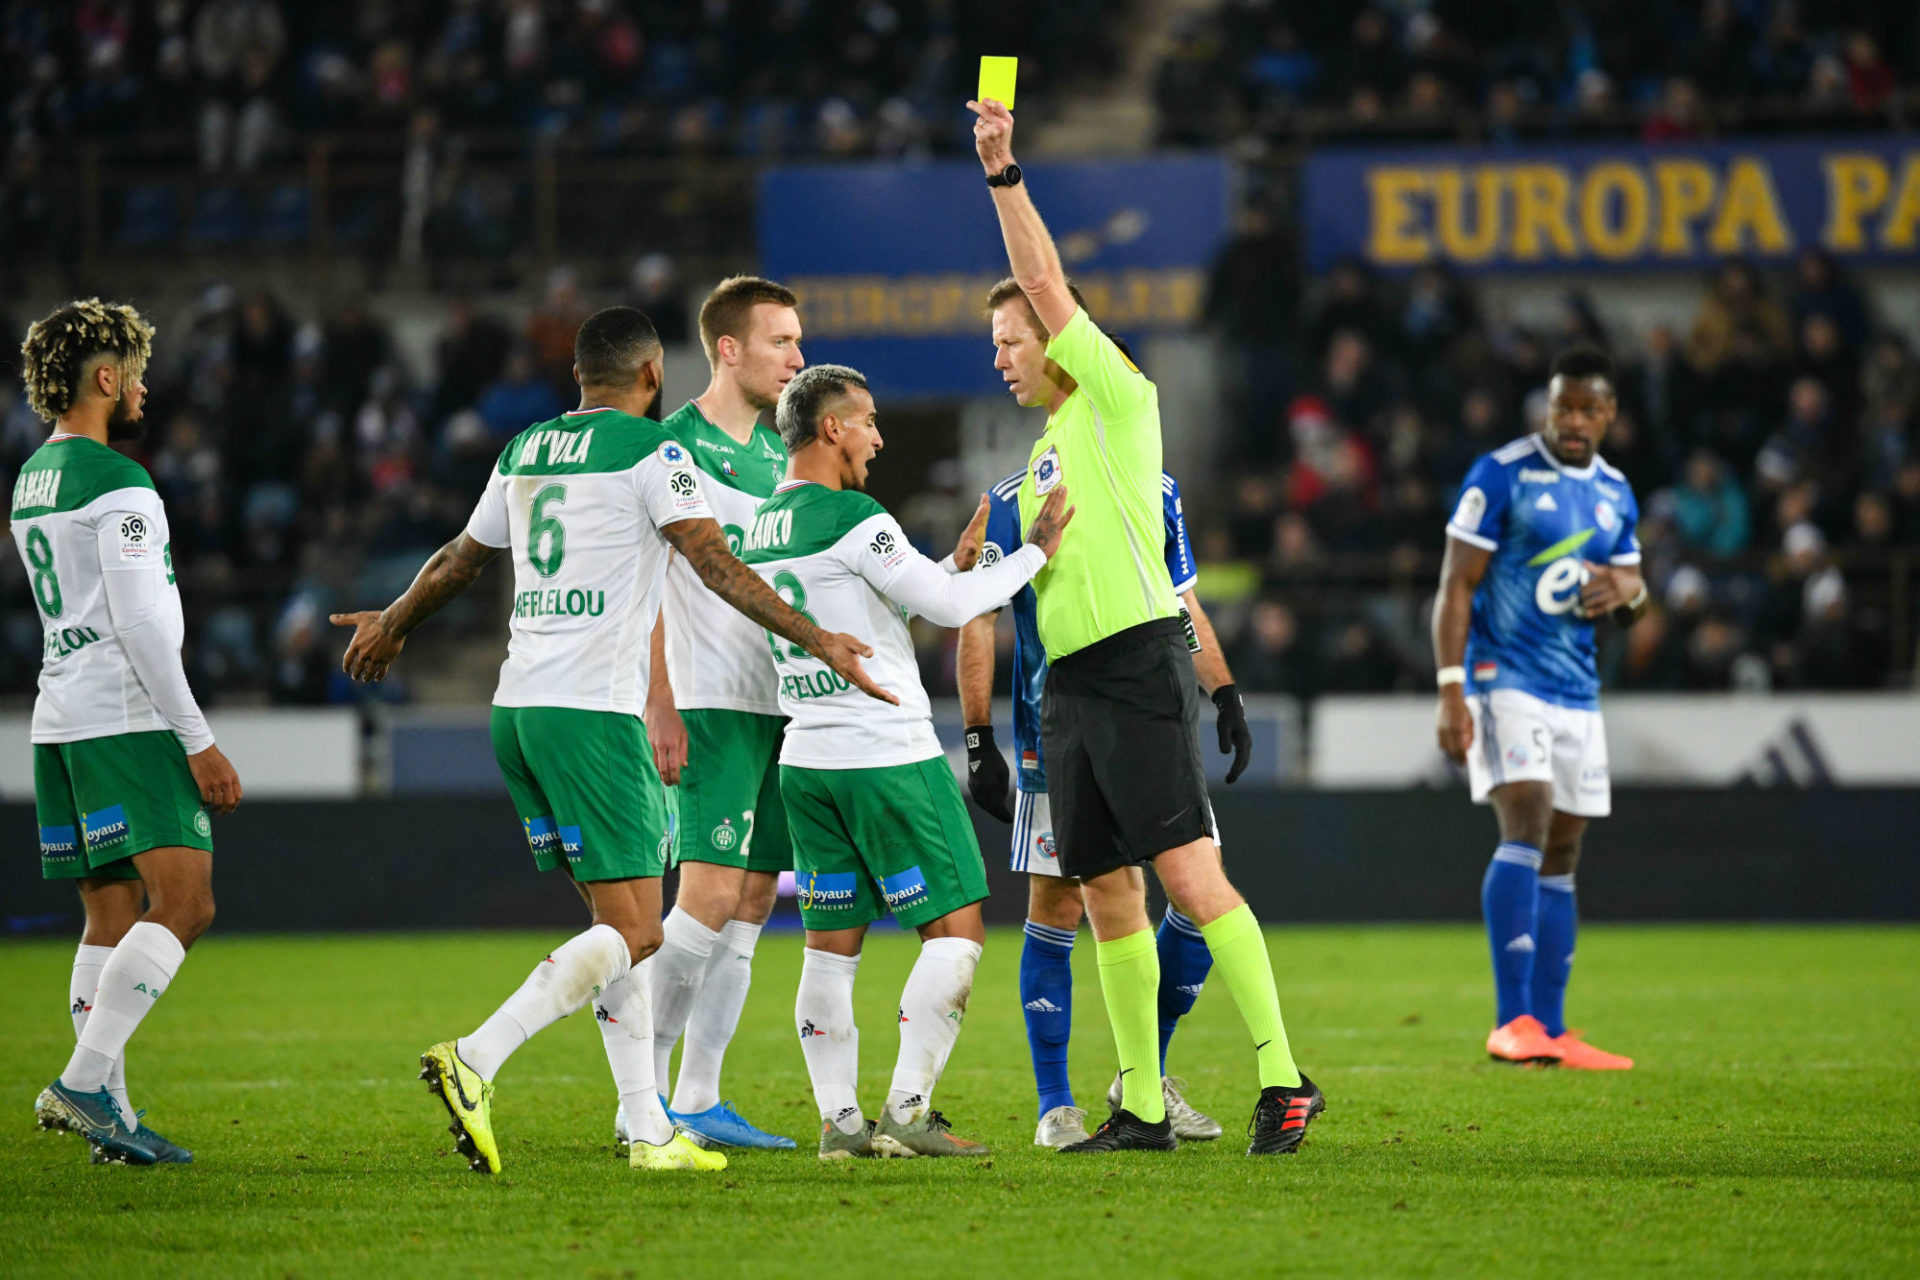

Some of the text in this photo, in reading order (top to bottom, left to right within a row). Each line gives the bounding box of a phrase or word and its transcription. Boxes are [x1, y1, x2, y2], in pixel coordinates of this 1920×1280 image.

[1367, 157, 1790, 263] EUROPA
[519, 428, 594, 467] M'VILA
[12, 469, 62, 512] AMARA
[528, 483, 569, 578] 6
[744, 509, 793, 551] RAUCO
[25, 525, 63, 618] 8
[516, 589, 605, 618] AFFLELOU
[1532, 727, 1545, 764] 5
